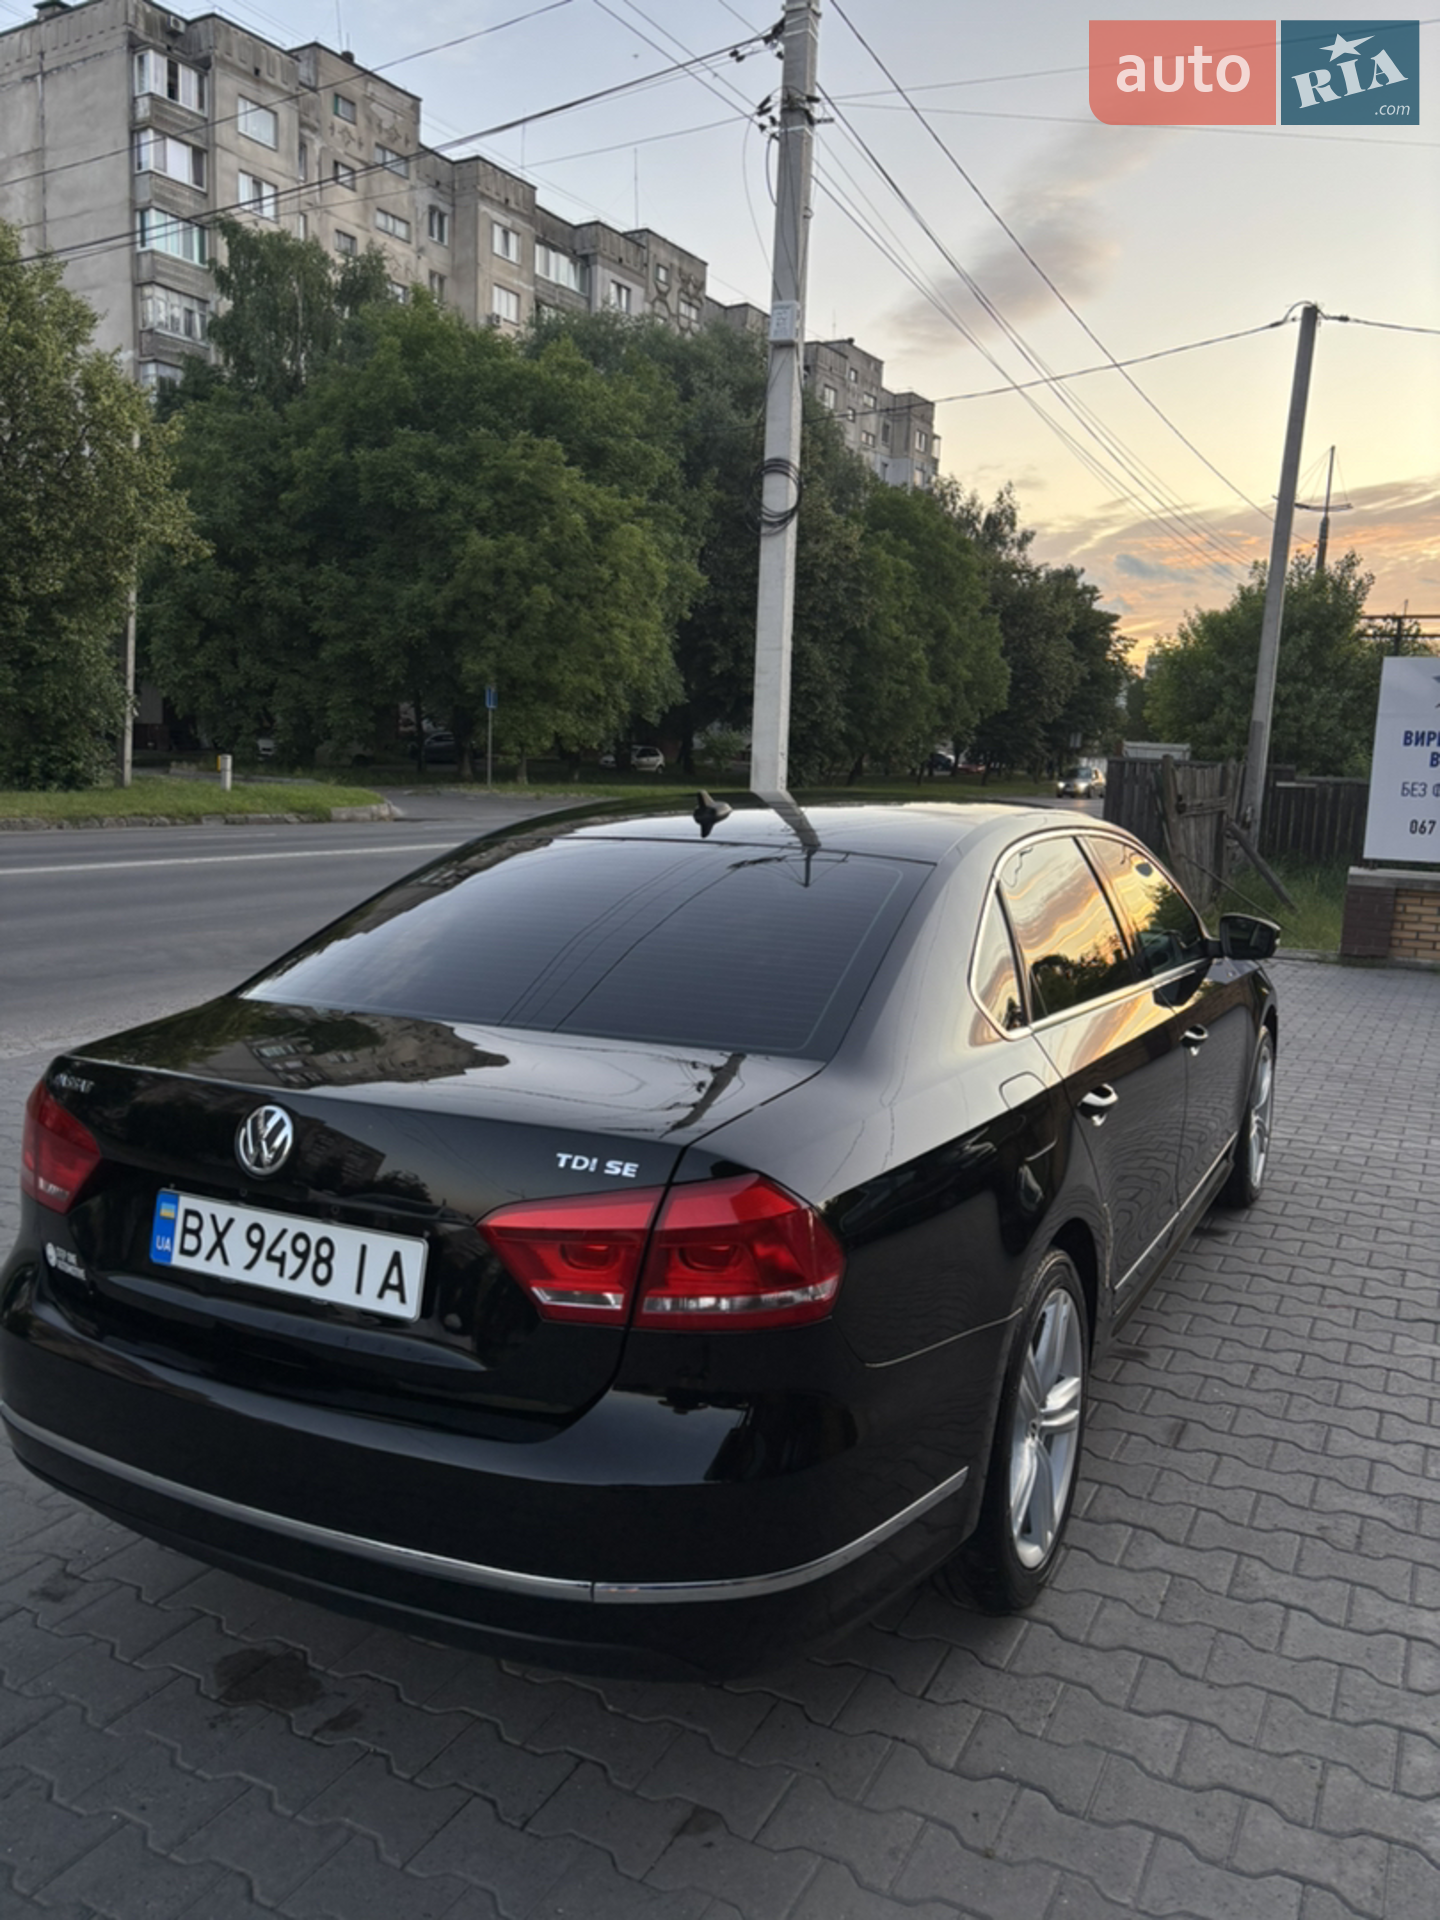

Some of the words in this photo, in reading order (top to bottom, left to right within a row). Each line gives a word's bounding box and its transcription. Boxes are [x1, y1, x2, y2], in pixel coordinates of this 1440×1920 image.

[1401, 781, 1428, 798] БЕЗ
[1409, 819, 1437, 835] 067
[556, 1152, 598, 1173] TDI
[604, 1159, 639, 1178] SE
[155, 1235, 172, 1252] UA
[178, 1208, 235, 1267] BX
[243, 1222, 335, 1287] 9498
[355, 1243, 407, 1305] IA
